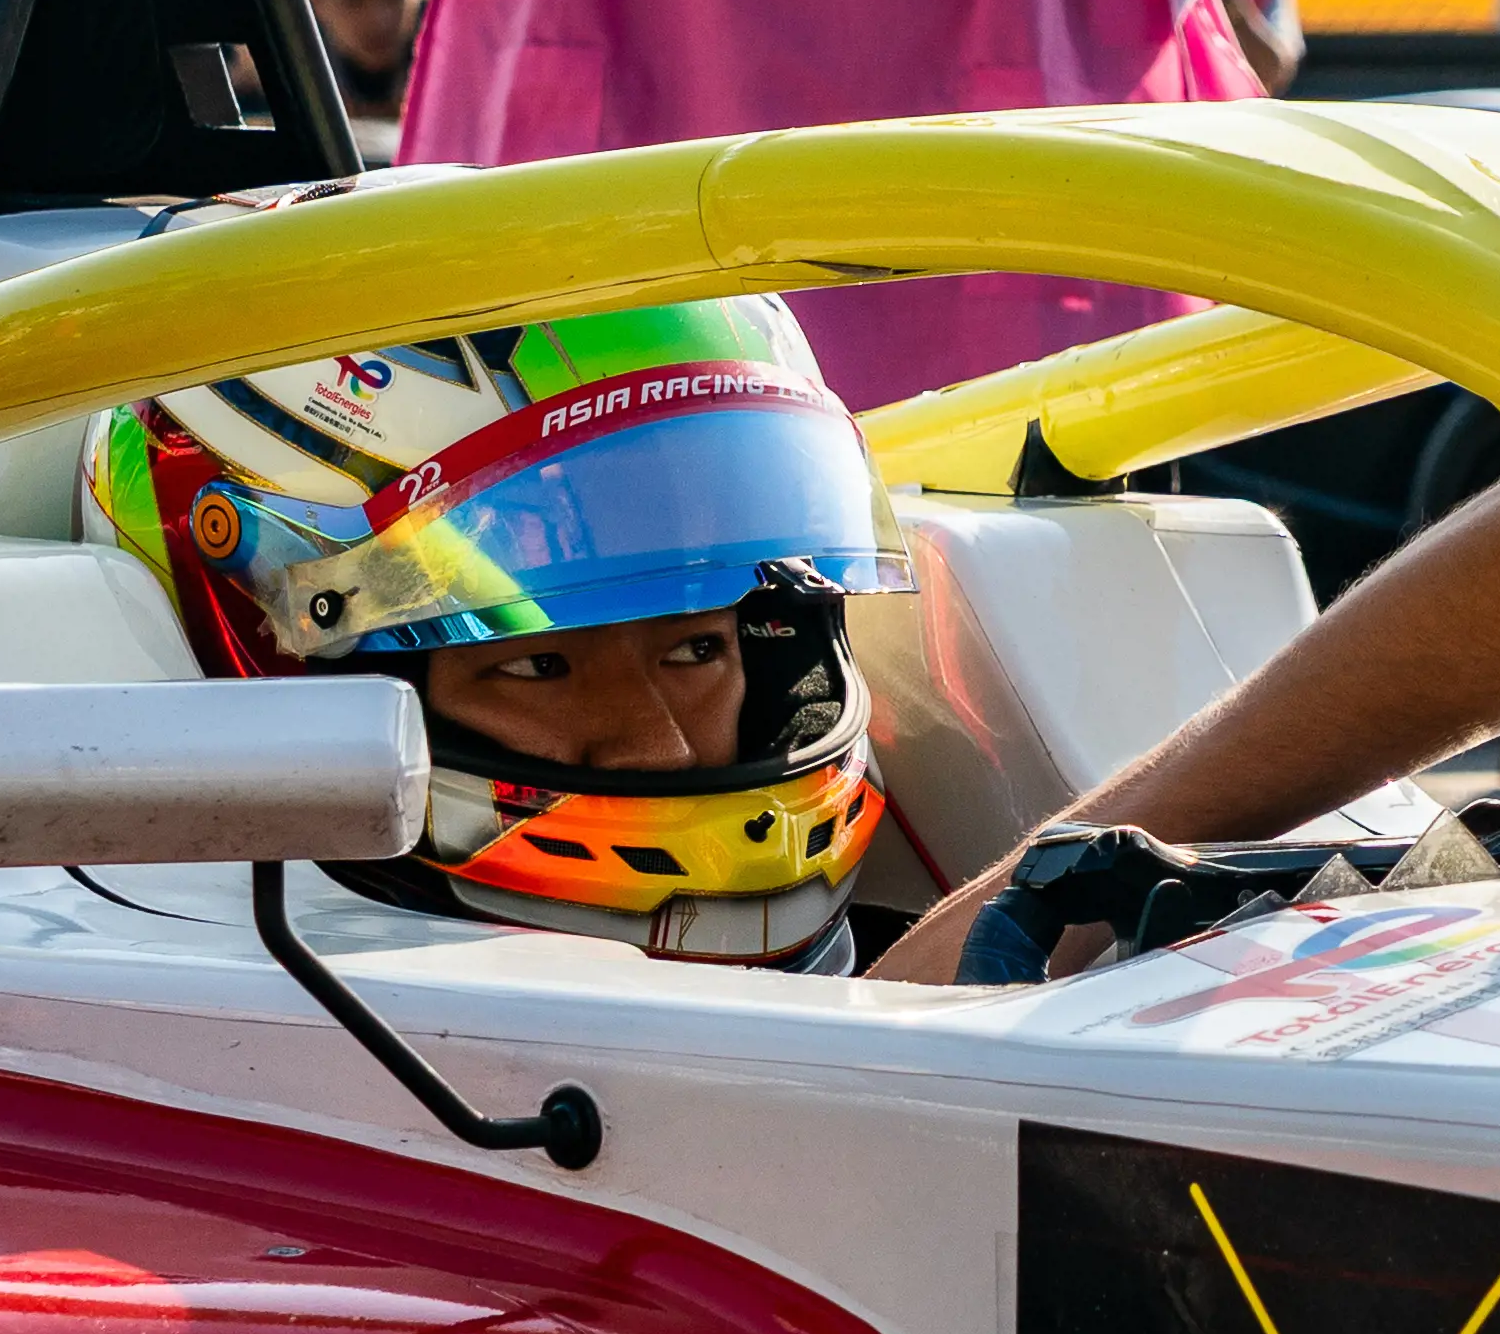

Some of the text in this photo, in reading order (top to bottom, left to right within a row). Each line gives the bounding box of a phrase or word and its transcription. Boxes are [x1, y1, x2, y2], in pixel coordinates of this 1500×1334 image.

[314, 382, 372, 420] TotalEnergies
[541, 387, 630, 438] ASIA
[640, 373, 765, 405] RACING
